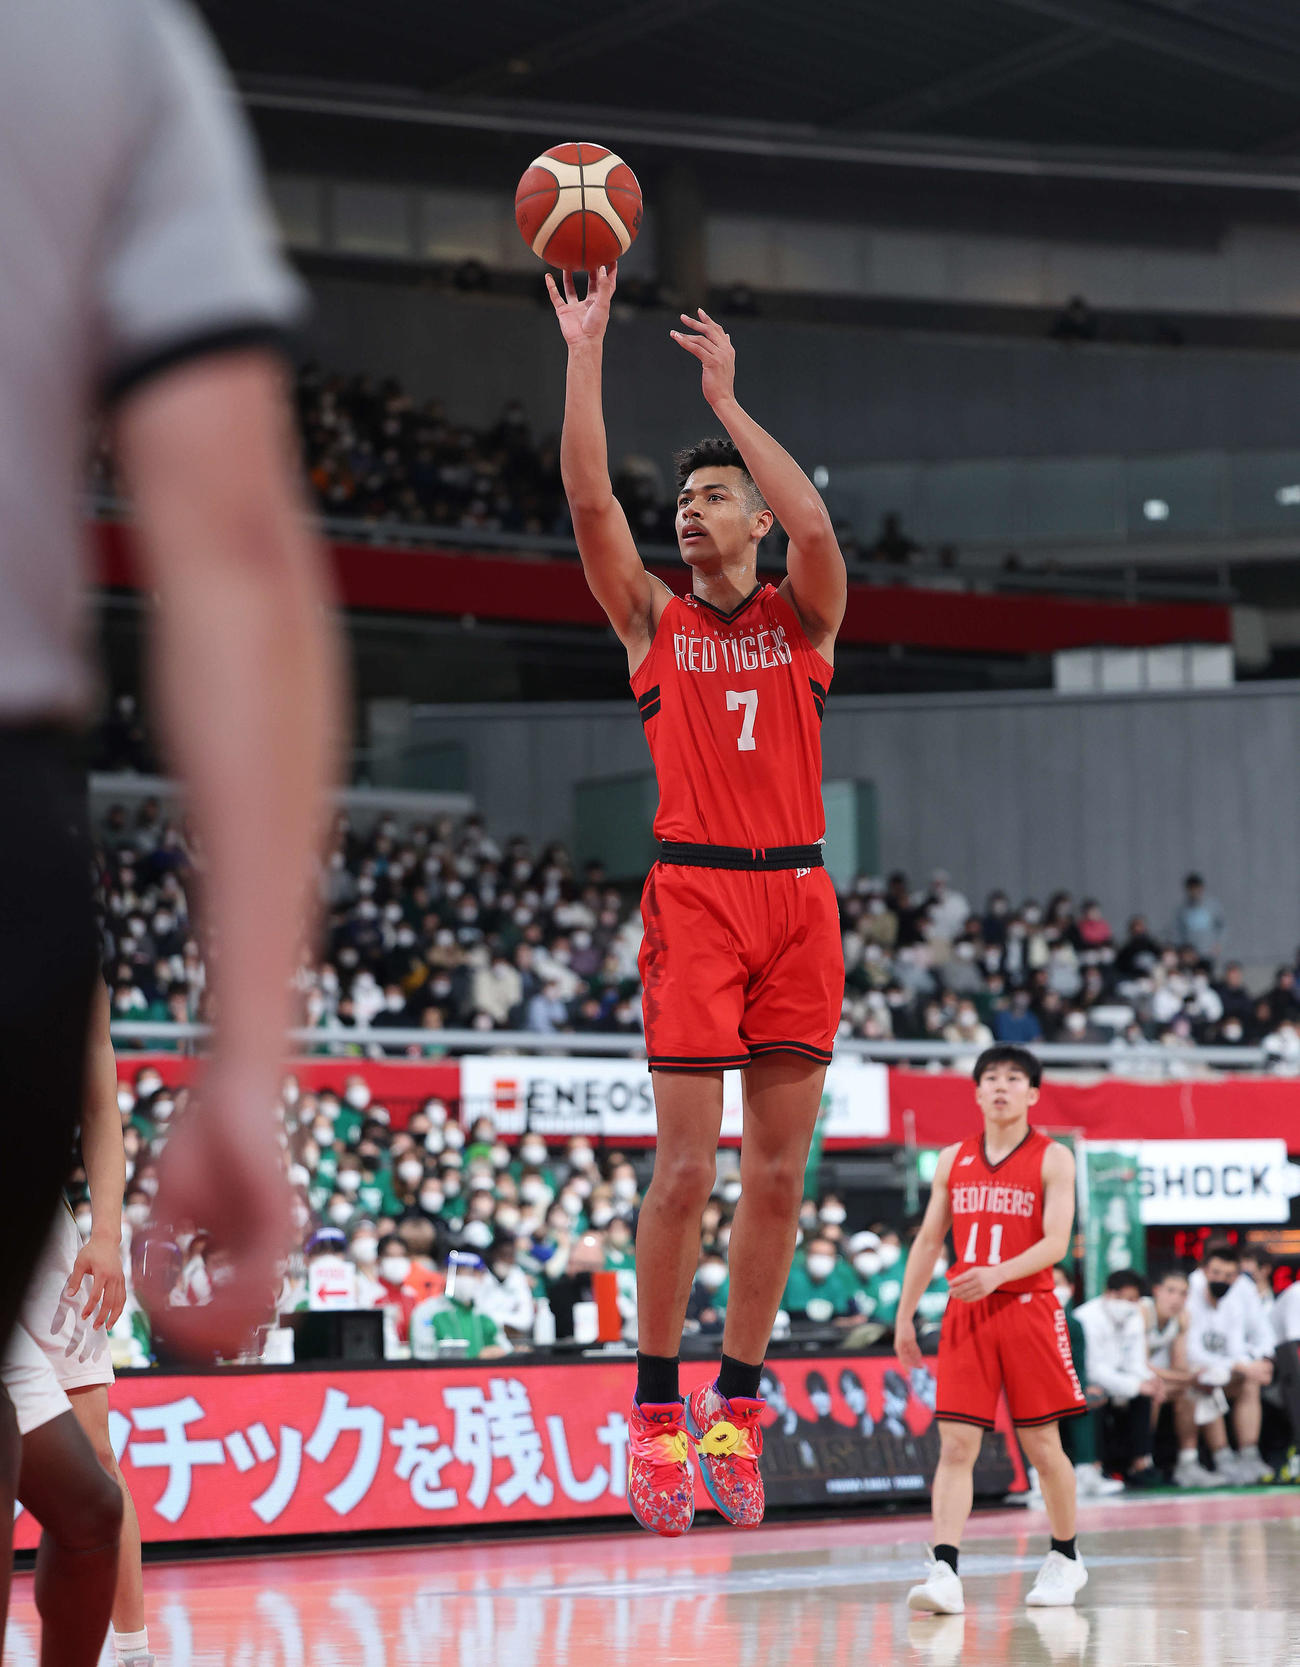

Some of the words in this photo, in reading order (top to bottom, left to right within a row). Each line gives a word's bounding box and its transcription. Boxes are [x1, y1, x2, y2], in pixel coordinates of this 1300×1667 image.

[725, 689, 758, 751] 7
[529, 1078, 655, 1116] ENEOS
[963, 1221, 1003, 1266] 11
